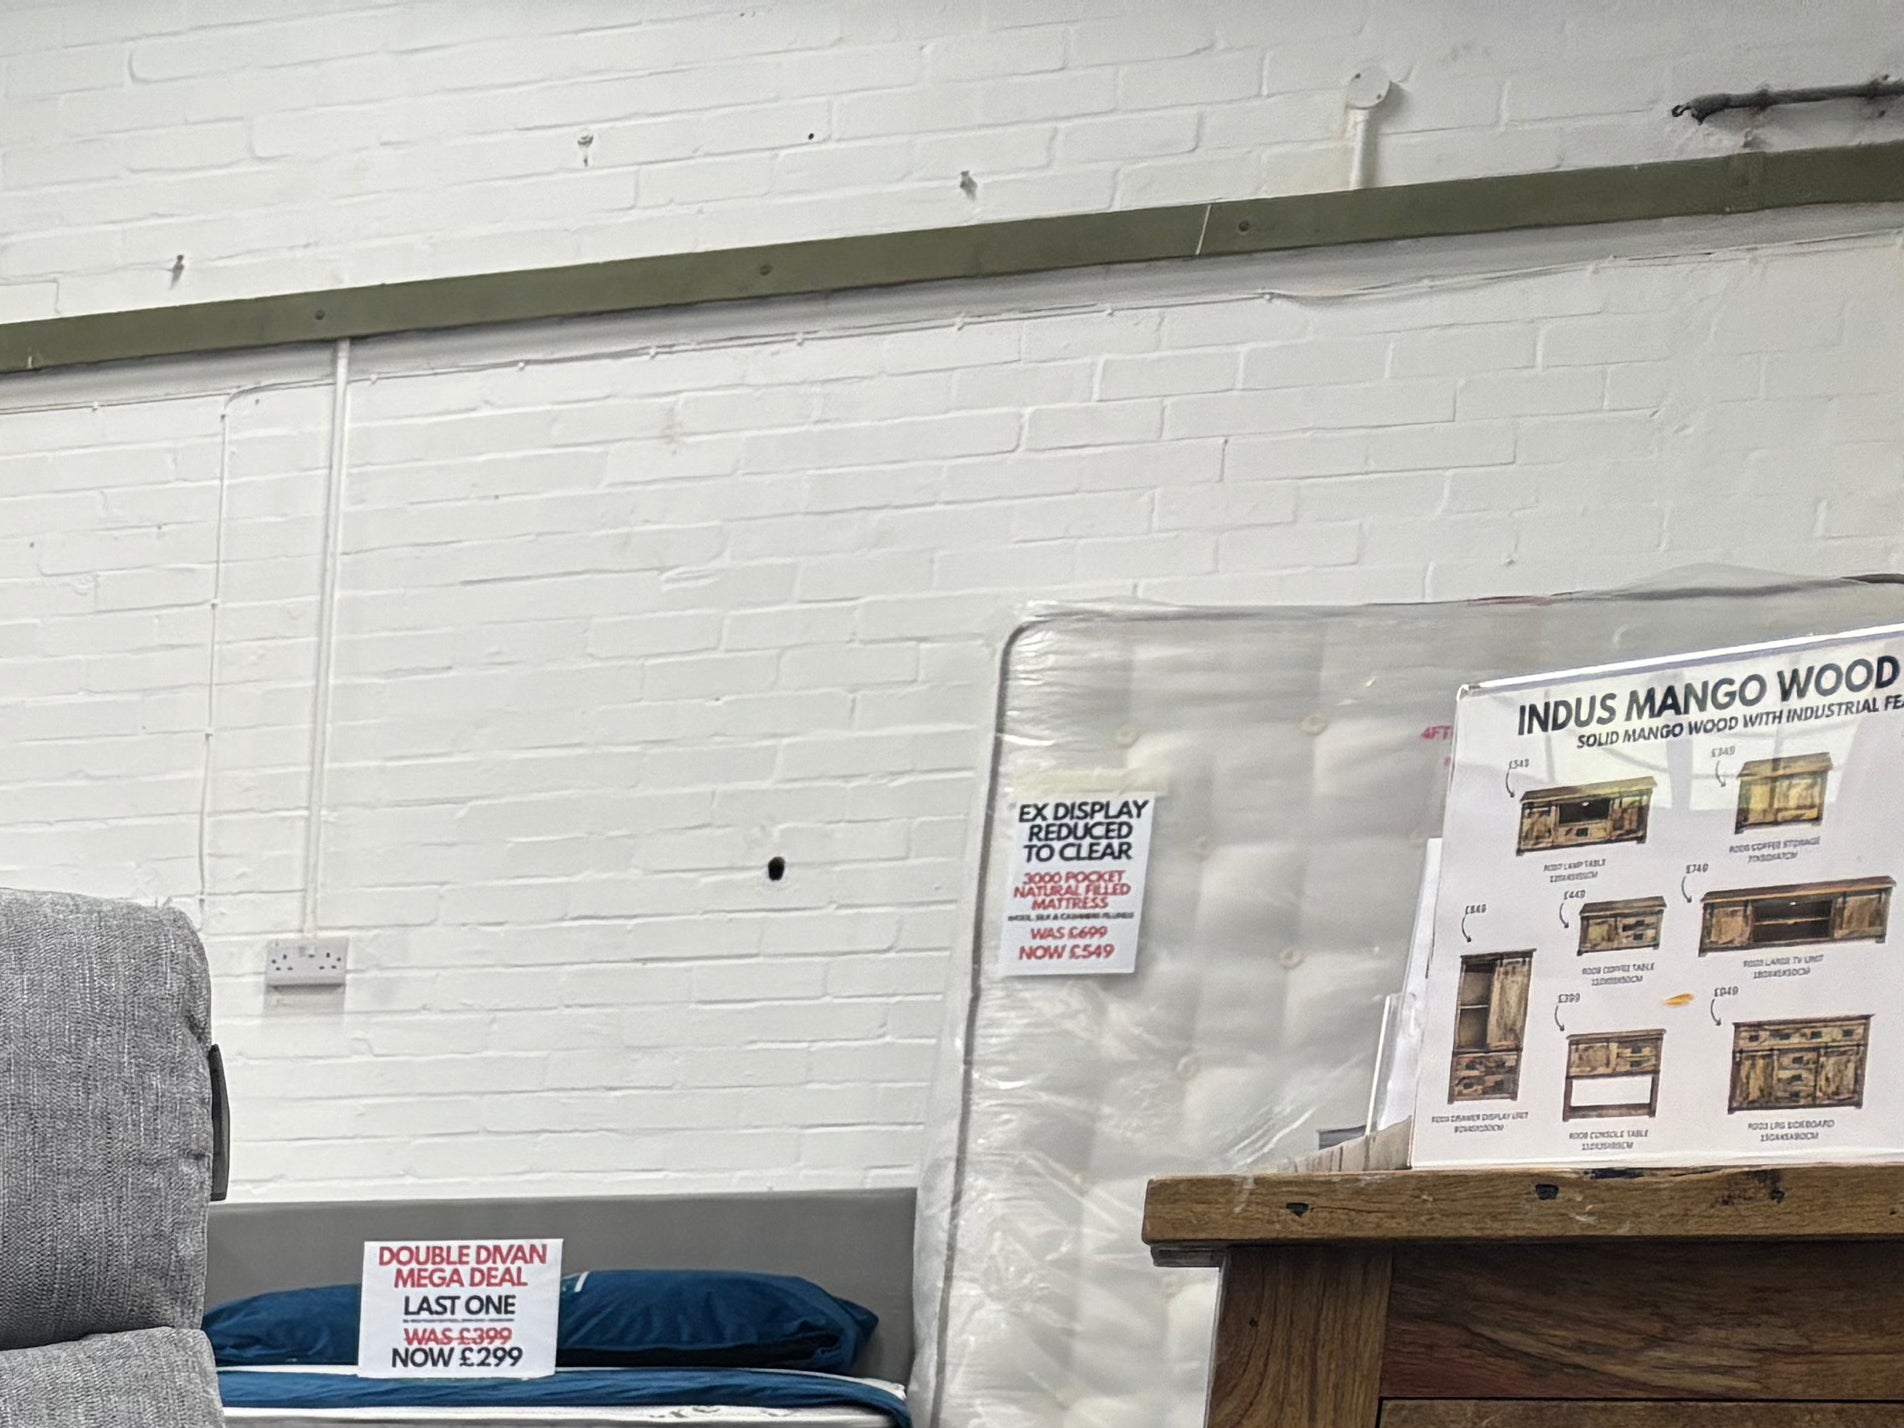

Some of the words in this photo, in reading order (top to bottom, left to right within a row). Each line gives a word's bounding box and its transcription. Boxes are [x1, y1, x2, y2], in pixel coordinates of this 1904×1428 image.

[1517, 693, 1617, 736] INDUS
[1624, 673, 1767, 723] MANGO
[1776, 654, 1901, 702] WOOD
[1576, 730, 1620, 749] SOLID
[1622, 722, 1684, 744] MANGO
[1687, 716, 1739, 736] WOOD
[1742, 708, 1784, 729] WITH
[1786, 697, 1880, 723] INDUSTRIAL
[1884, 693, 1904, 712] FE
[1018, 802, 1049, 823] EX
[1052, 799, 1149, 821] DISPLAY
[1028, 821, 1133, 843] REDUCED
[1024, 844, 1056, 863] TO
[1059, 841, 1133, 862] CLEAR
[1023, 872, 1062, 885] 3000
[1064, 869, 1126, 884] POCKET
[1013, 884, 1081, 898] NATURAL
[1085, 882, 1132, 897] FILLED
[1030, 896, 1109, 910] MATTRESS
[1031, 926, 1065, 940] WAS
[1067, 925, 1108, 940] £699
[1019, 944, 1067, 960] NOW
[1069, 943, 1116, 959] £549
[378, 1245, 471, 1266] DOUBLE
[475, 1244, 547, 1265] DIVAN
[394, 1267, 464, 1288] MEGA
[469, 1266, 528, 1288] DEAL
[403, 1295, 460, 1316] LAST
[464, 1294, 517, 1315] ONE
[403, 1327, 454, 1346] WAS
[456, 1327, 513, 1346] £399
[391, 1347, 454, 1368] NOW
[459, 1346, 523, 1368] £299
